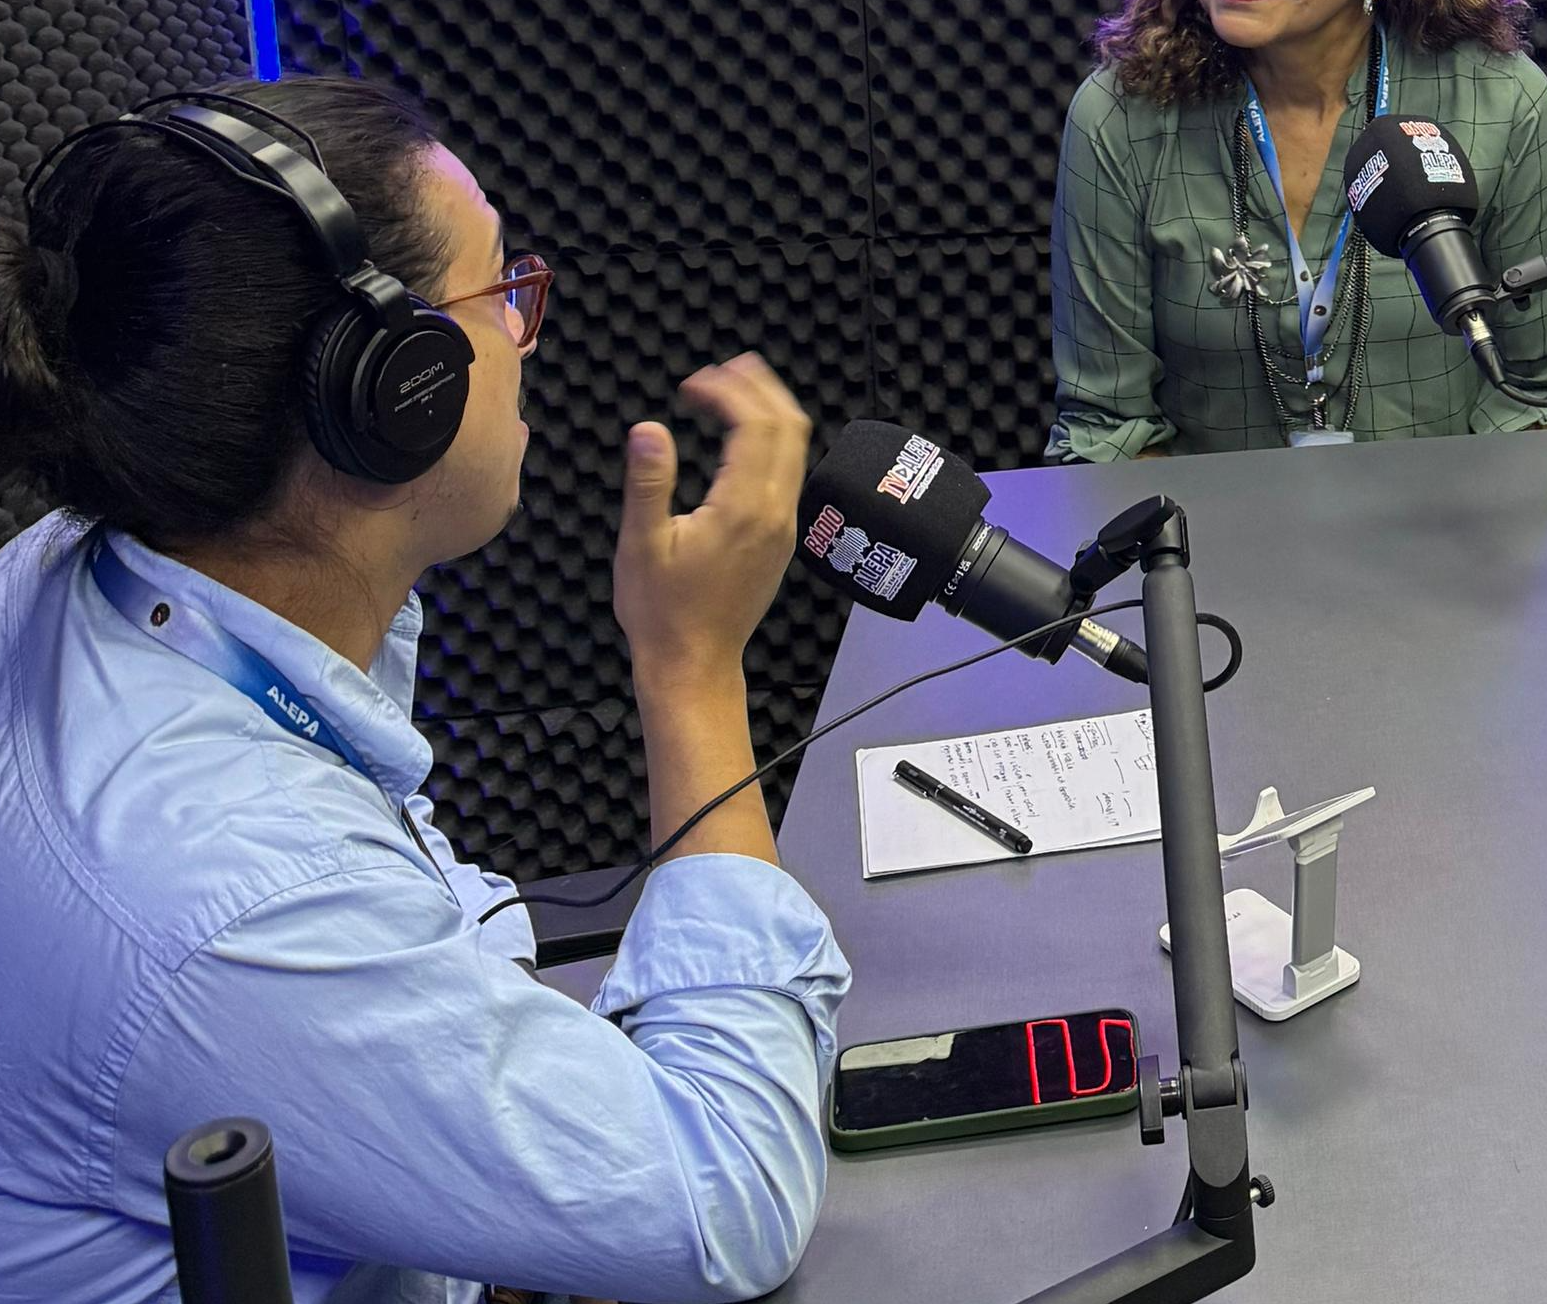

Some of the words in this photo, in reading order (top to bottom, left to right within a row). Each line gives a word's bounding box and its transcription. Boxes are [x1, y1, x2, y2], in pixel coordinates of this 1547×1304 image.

[1248, 99, 1266, 142] ALEPA
[398, 360, 445, 394] ZOOM
[876, 468, 910, 499] TV
[804, 504, 845, 559] RÁDIO
[852, 541, 901, 594] ALEPA
[265, 684, 321, 739] ALEPA
